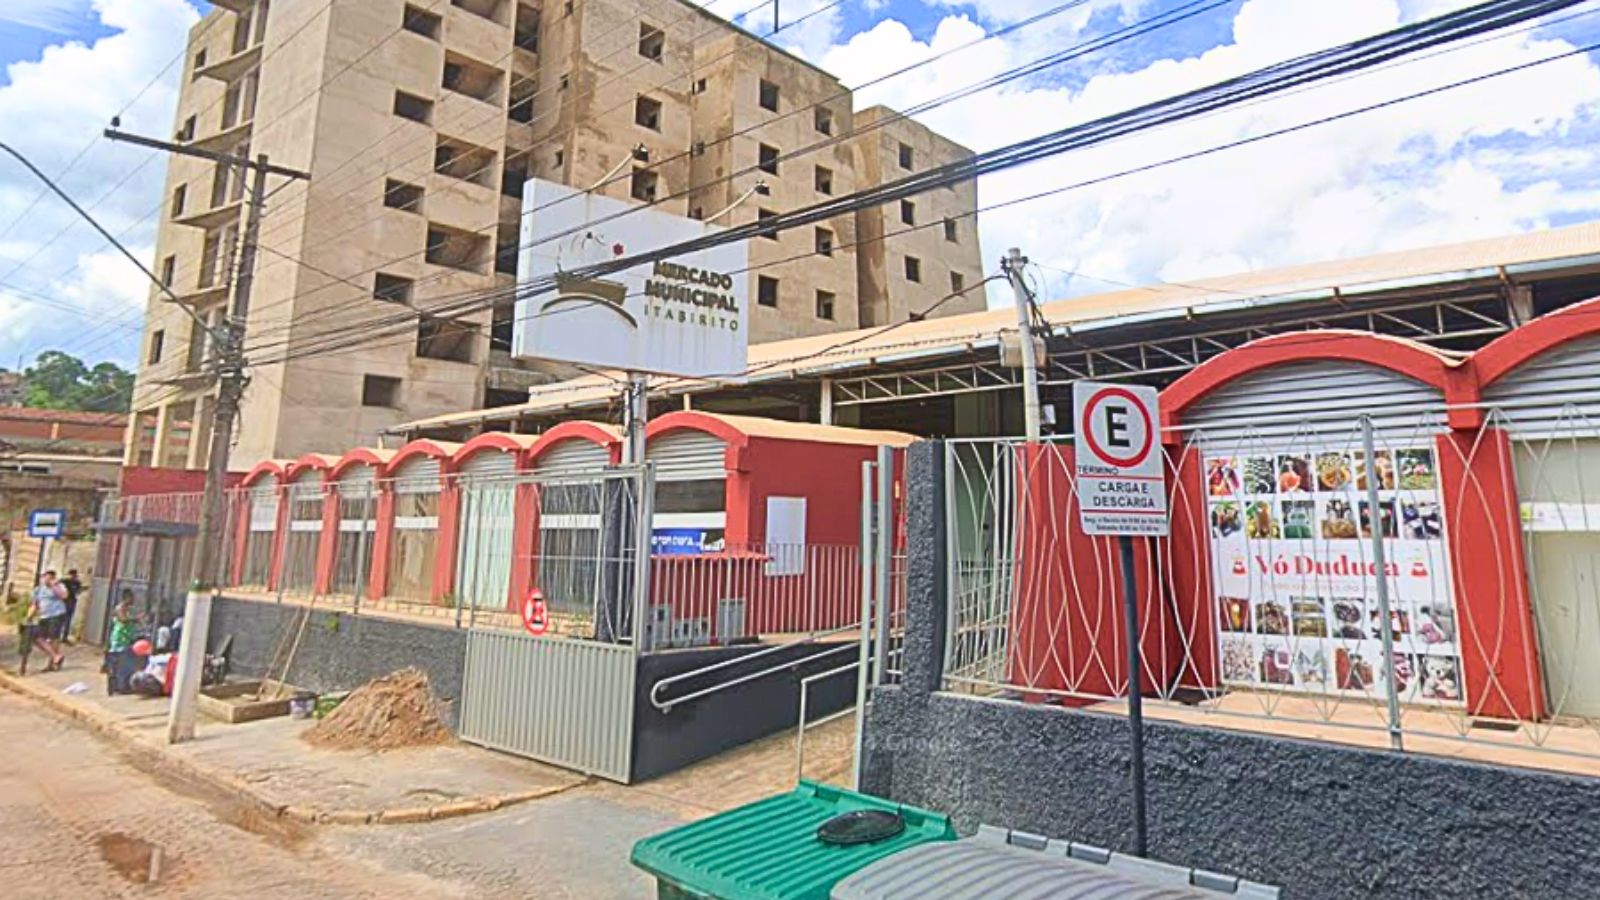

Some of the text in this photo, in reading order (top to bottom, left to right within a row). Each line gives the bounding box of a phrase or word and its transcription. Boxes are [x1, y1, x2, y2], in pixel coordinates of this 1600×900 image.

[653, 259, 732, 290] MERCADO
[644, 279, 739, 314] MUNICIPAL
[644, 304, 738, 331] ITABIRITO
[1105, 405, 1130, 448] E
[1092, 495, 1155, 508] DESCARGA
[1098, 481, 1149, 494] CARGA E
